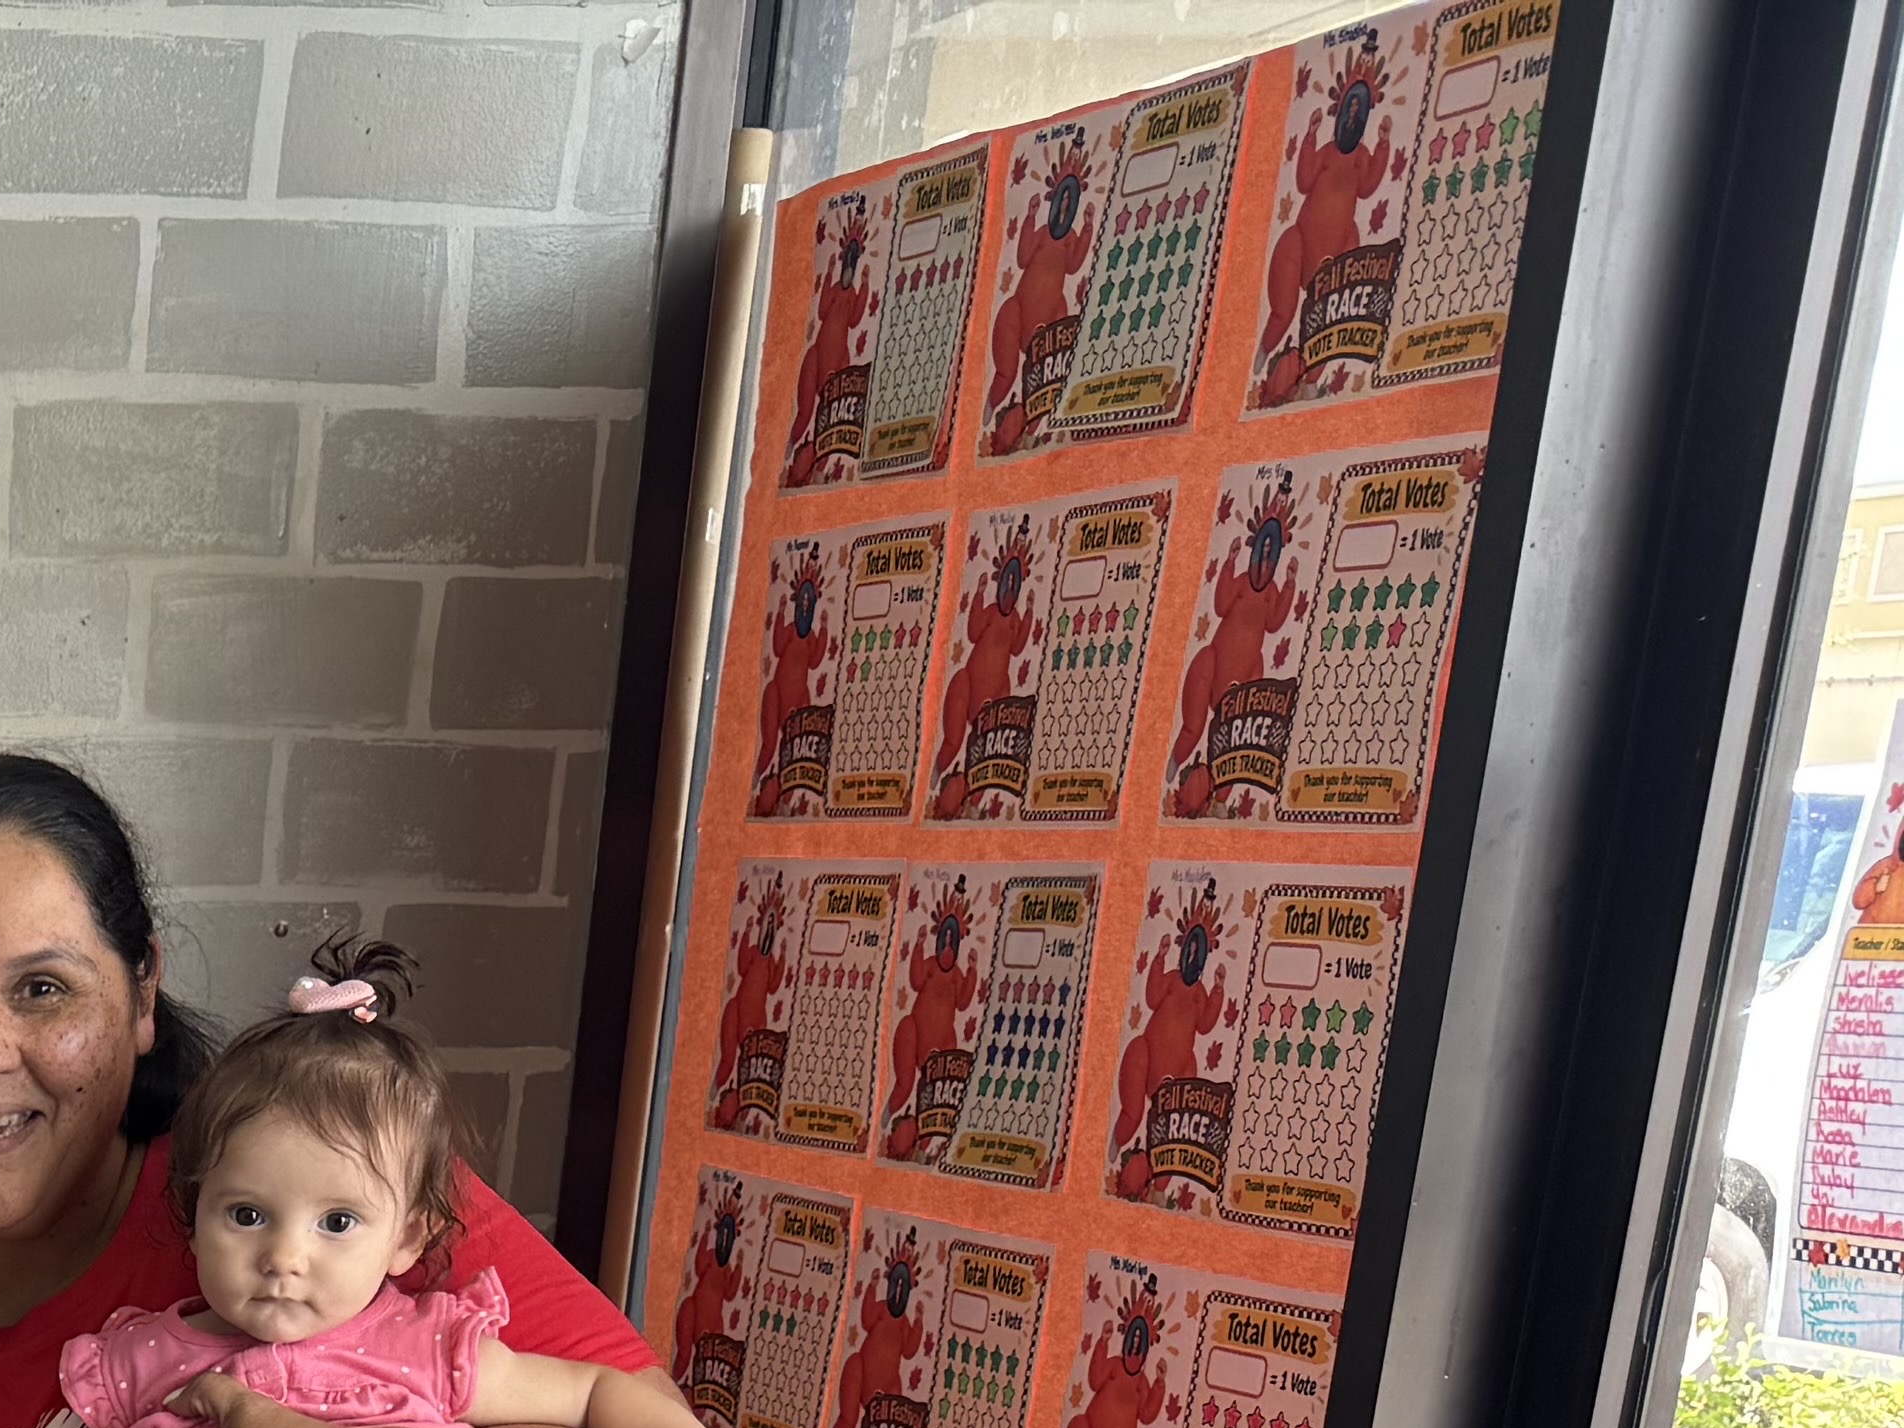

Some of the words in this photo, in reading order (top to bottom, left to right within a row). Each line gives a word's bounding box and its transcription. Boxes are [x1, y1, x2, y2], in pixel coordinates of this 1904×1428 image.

[1459, 14, 1502, 58] Total
[1507, 3, 1552, 39] Votes
[1145, 106, 1182, 143] Total
[1187, 99, 1223, 132] Votes
[1325, 286, 1371, 325] RACE
[1306, 330, 1333, 359] VOTE
[1360, 481, 1398, 515] Total
[1406, 478, 1450, 510] Votes
[1080, 523, 1109, 551] Total
[1112, 518, 1144, 546] Votes
[865, 550, 890, 577] Total
[895, 544, 924, 571] Votes
[1230, 714, 1271, 748] RACE
[1214, 754, 1237, 779] VOTE
[1284, 904, 1322, 937] Total
[1327, 907, 1371, 940] Votes
[1167, 1113, 1211, 1145] RACE
[1153, 1150, 1176, 1169] VOTE
[962, 1259, 988, 1288] Total
[992, 1266, 1027, 1297] Votes
[1227, 1312, 1268, 1348] Total
[1272, 1320, 1319, 1359] Votes
